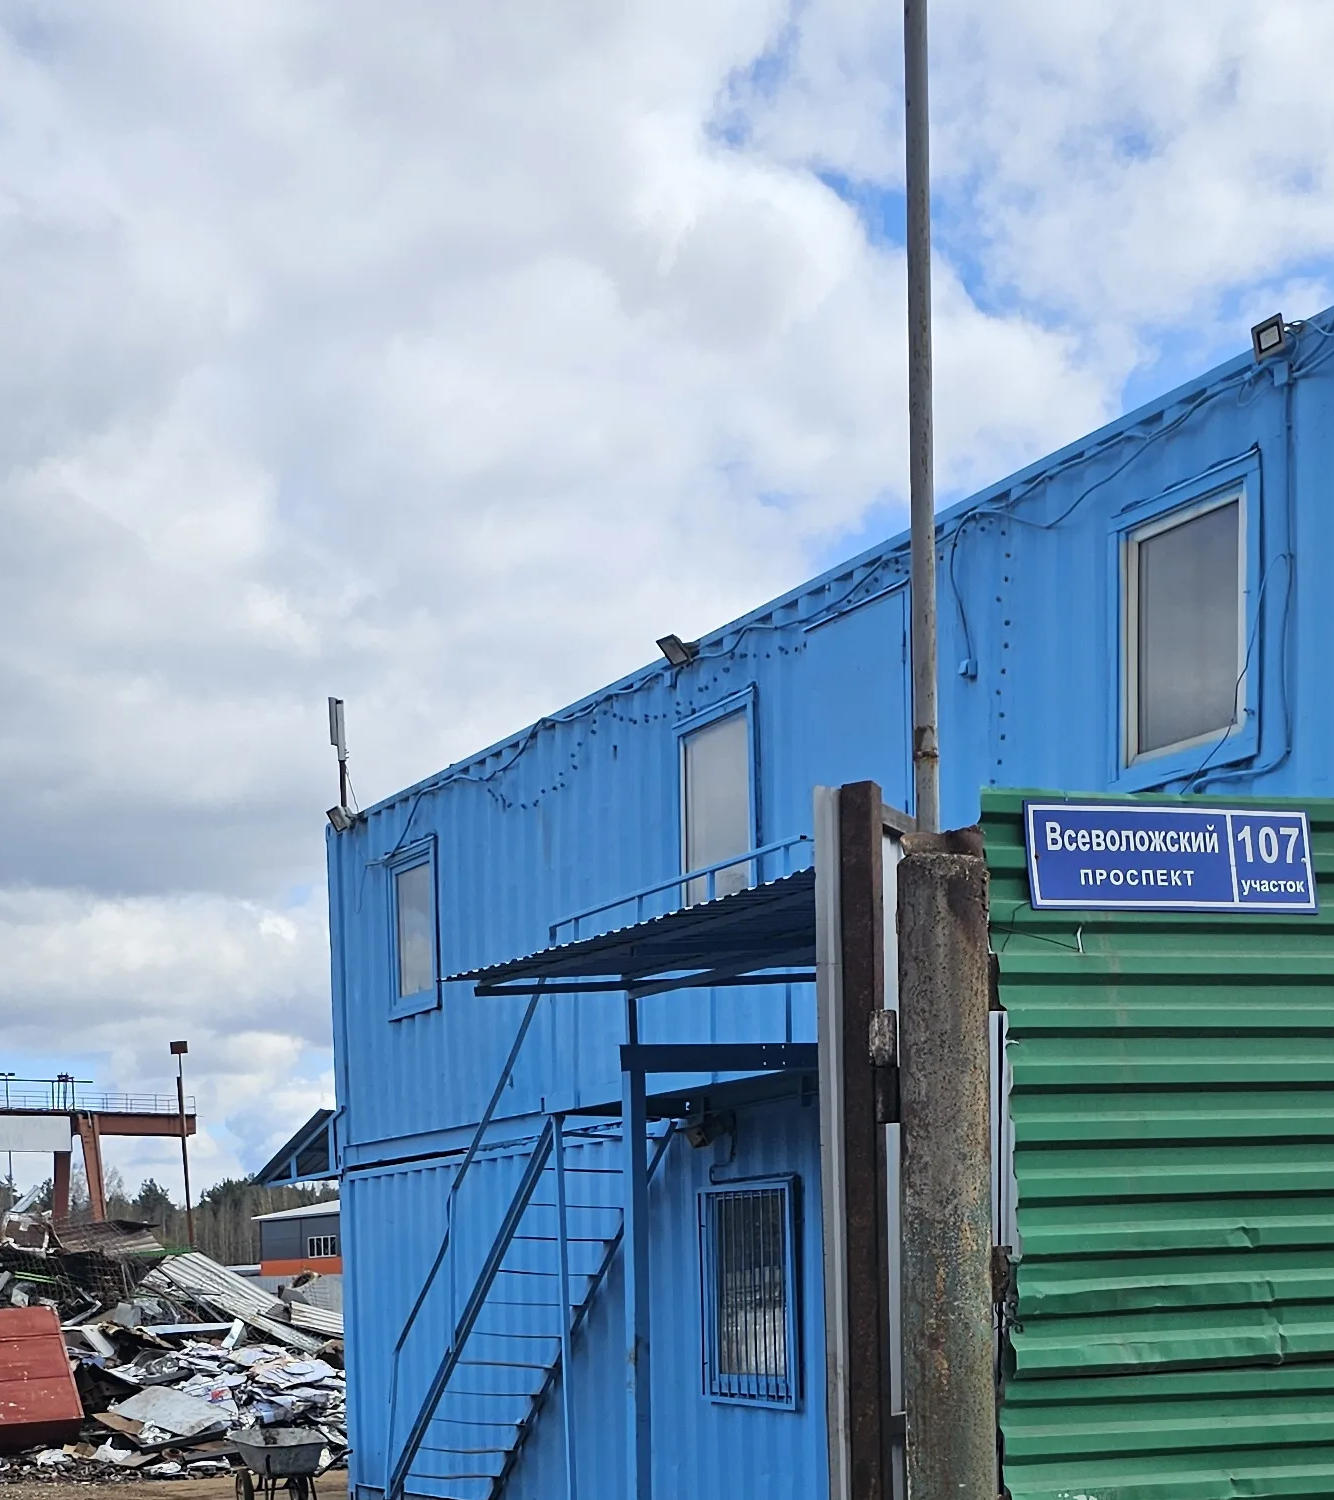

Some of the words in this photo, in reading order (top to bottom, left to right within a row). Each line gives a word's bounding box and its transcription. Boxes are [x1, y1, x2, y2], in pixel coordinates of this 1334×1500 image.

[1045, 821, 1219, 854] Всеволожский
[1237, 825, 1300, 864] 107
[1079, 869, 1195, 887] ПРОСПЕКТ
[1240, 879, 1305, 896] участок
